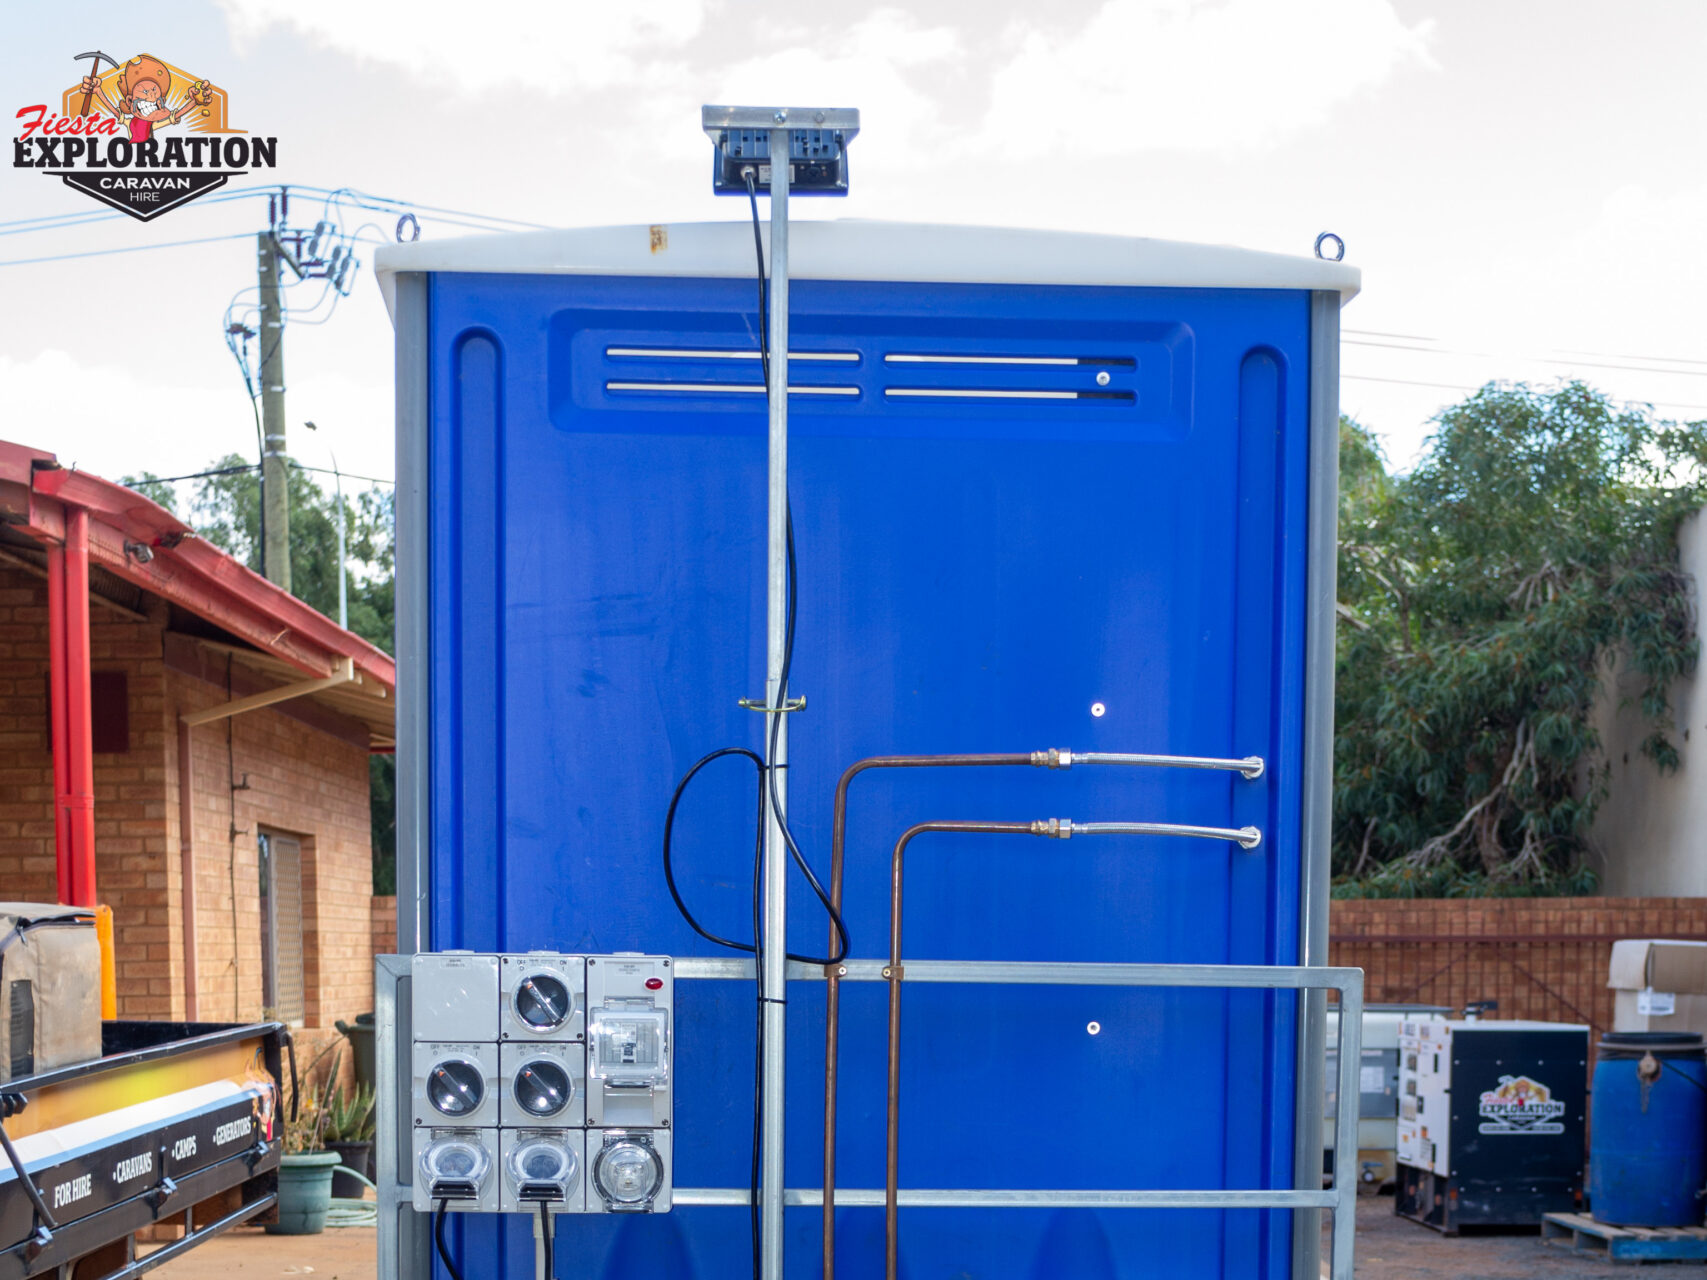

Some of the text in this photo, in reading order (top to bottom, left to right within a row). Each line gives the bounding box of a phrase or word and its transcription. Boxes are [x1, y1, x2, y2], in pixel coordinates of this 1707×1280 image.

[1482, 1104, 1562, 1113] EXPLORATION
[54, 1116, 251, 1208] FOR HIRE CARAVANS CAMPS GENERATORS
